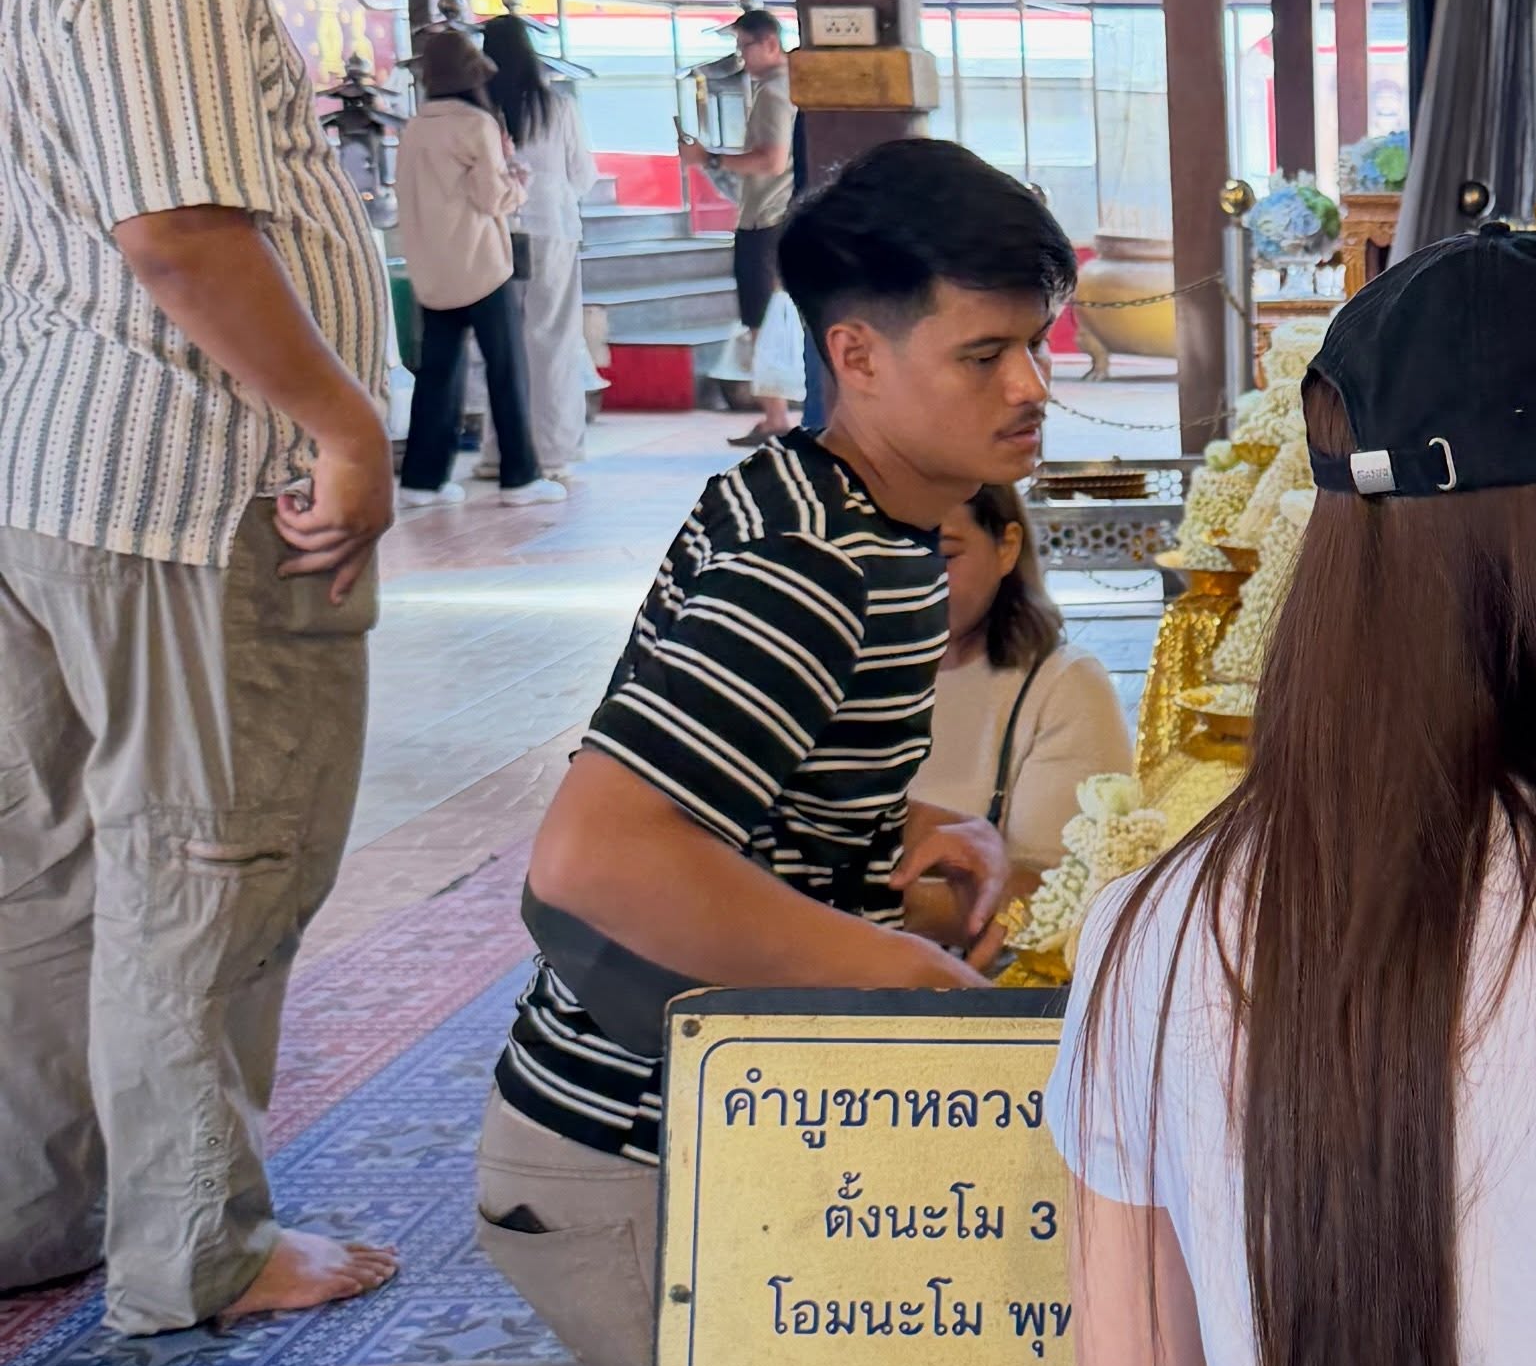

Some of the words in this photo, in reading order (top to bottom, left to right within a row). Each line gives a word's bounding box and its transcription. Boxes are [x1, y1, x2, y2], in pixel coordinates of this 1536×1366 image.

[723, 1067, 1044, 1149] คำบูชาหลวง
[824, 1171, 1005, 1239] ตั้งนะโม
[1030, 1200, 1058, 1240] 3
[767, 1275, 983, 1336] โอมนะโม
